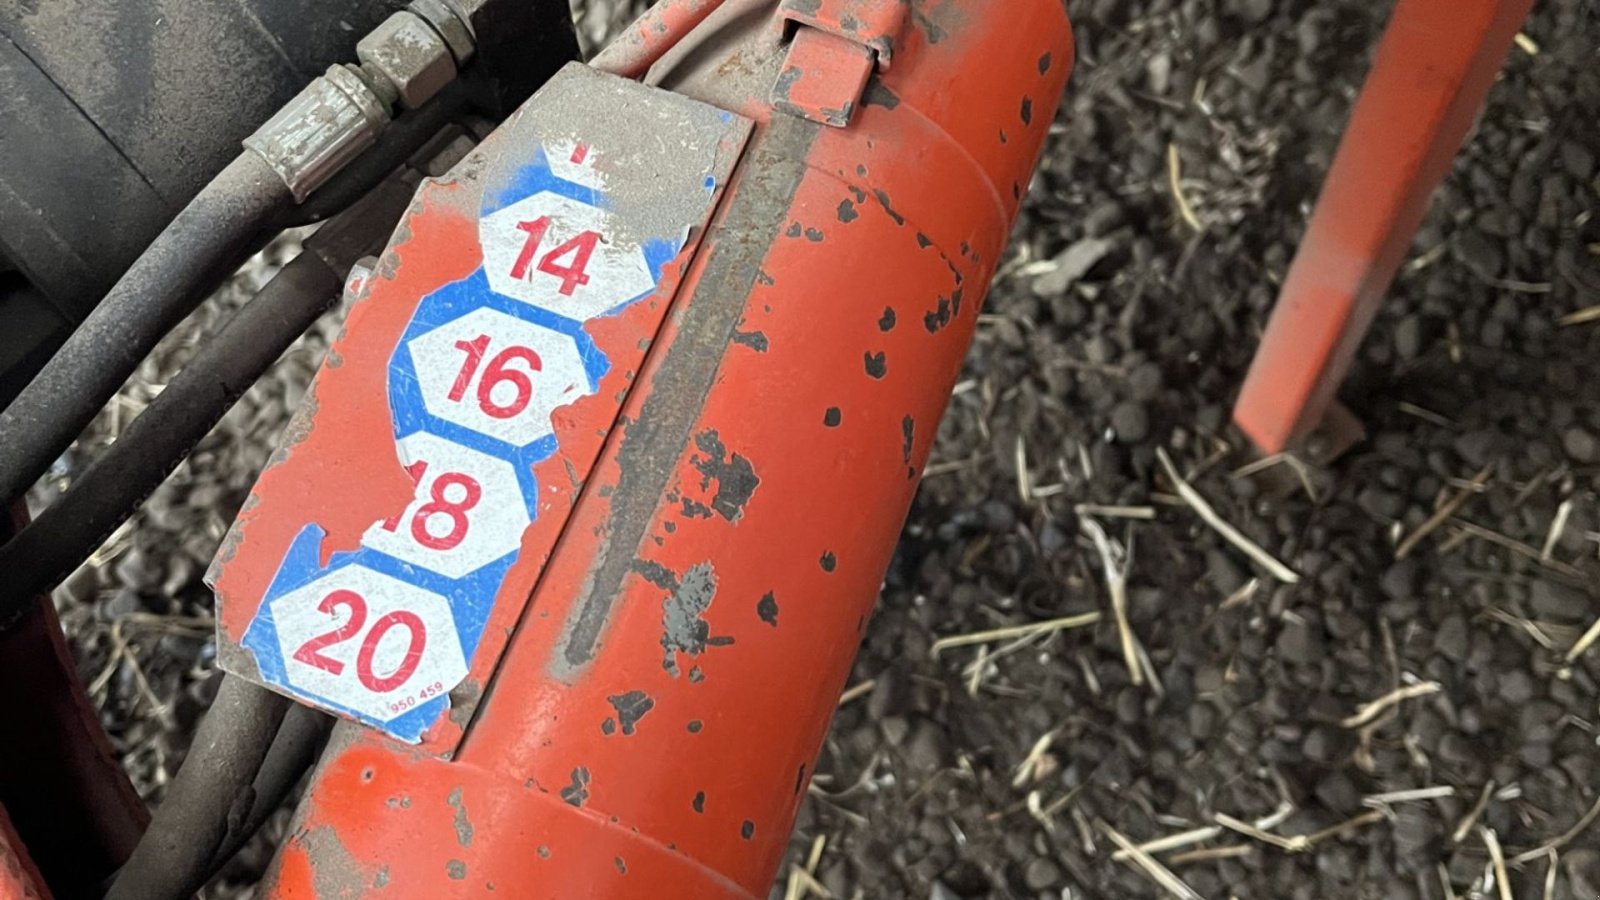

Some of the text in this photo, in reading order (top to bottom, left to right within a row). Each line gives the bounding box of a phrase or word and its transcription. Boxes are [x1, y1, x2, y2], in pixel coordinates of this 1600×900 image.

[509, 215, 600, 297] 14
[447, 334, 543, 419] 16
[292, 589, 427, 693] 20
[391, 682, 443, 713] 950 459
